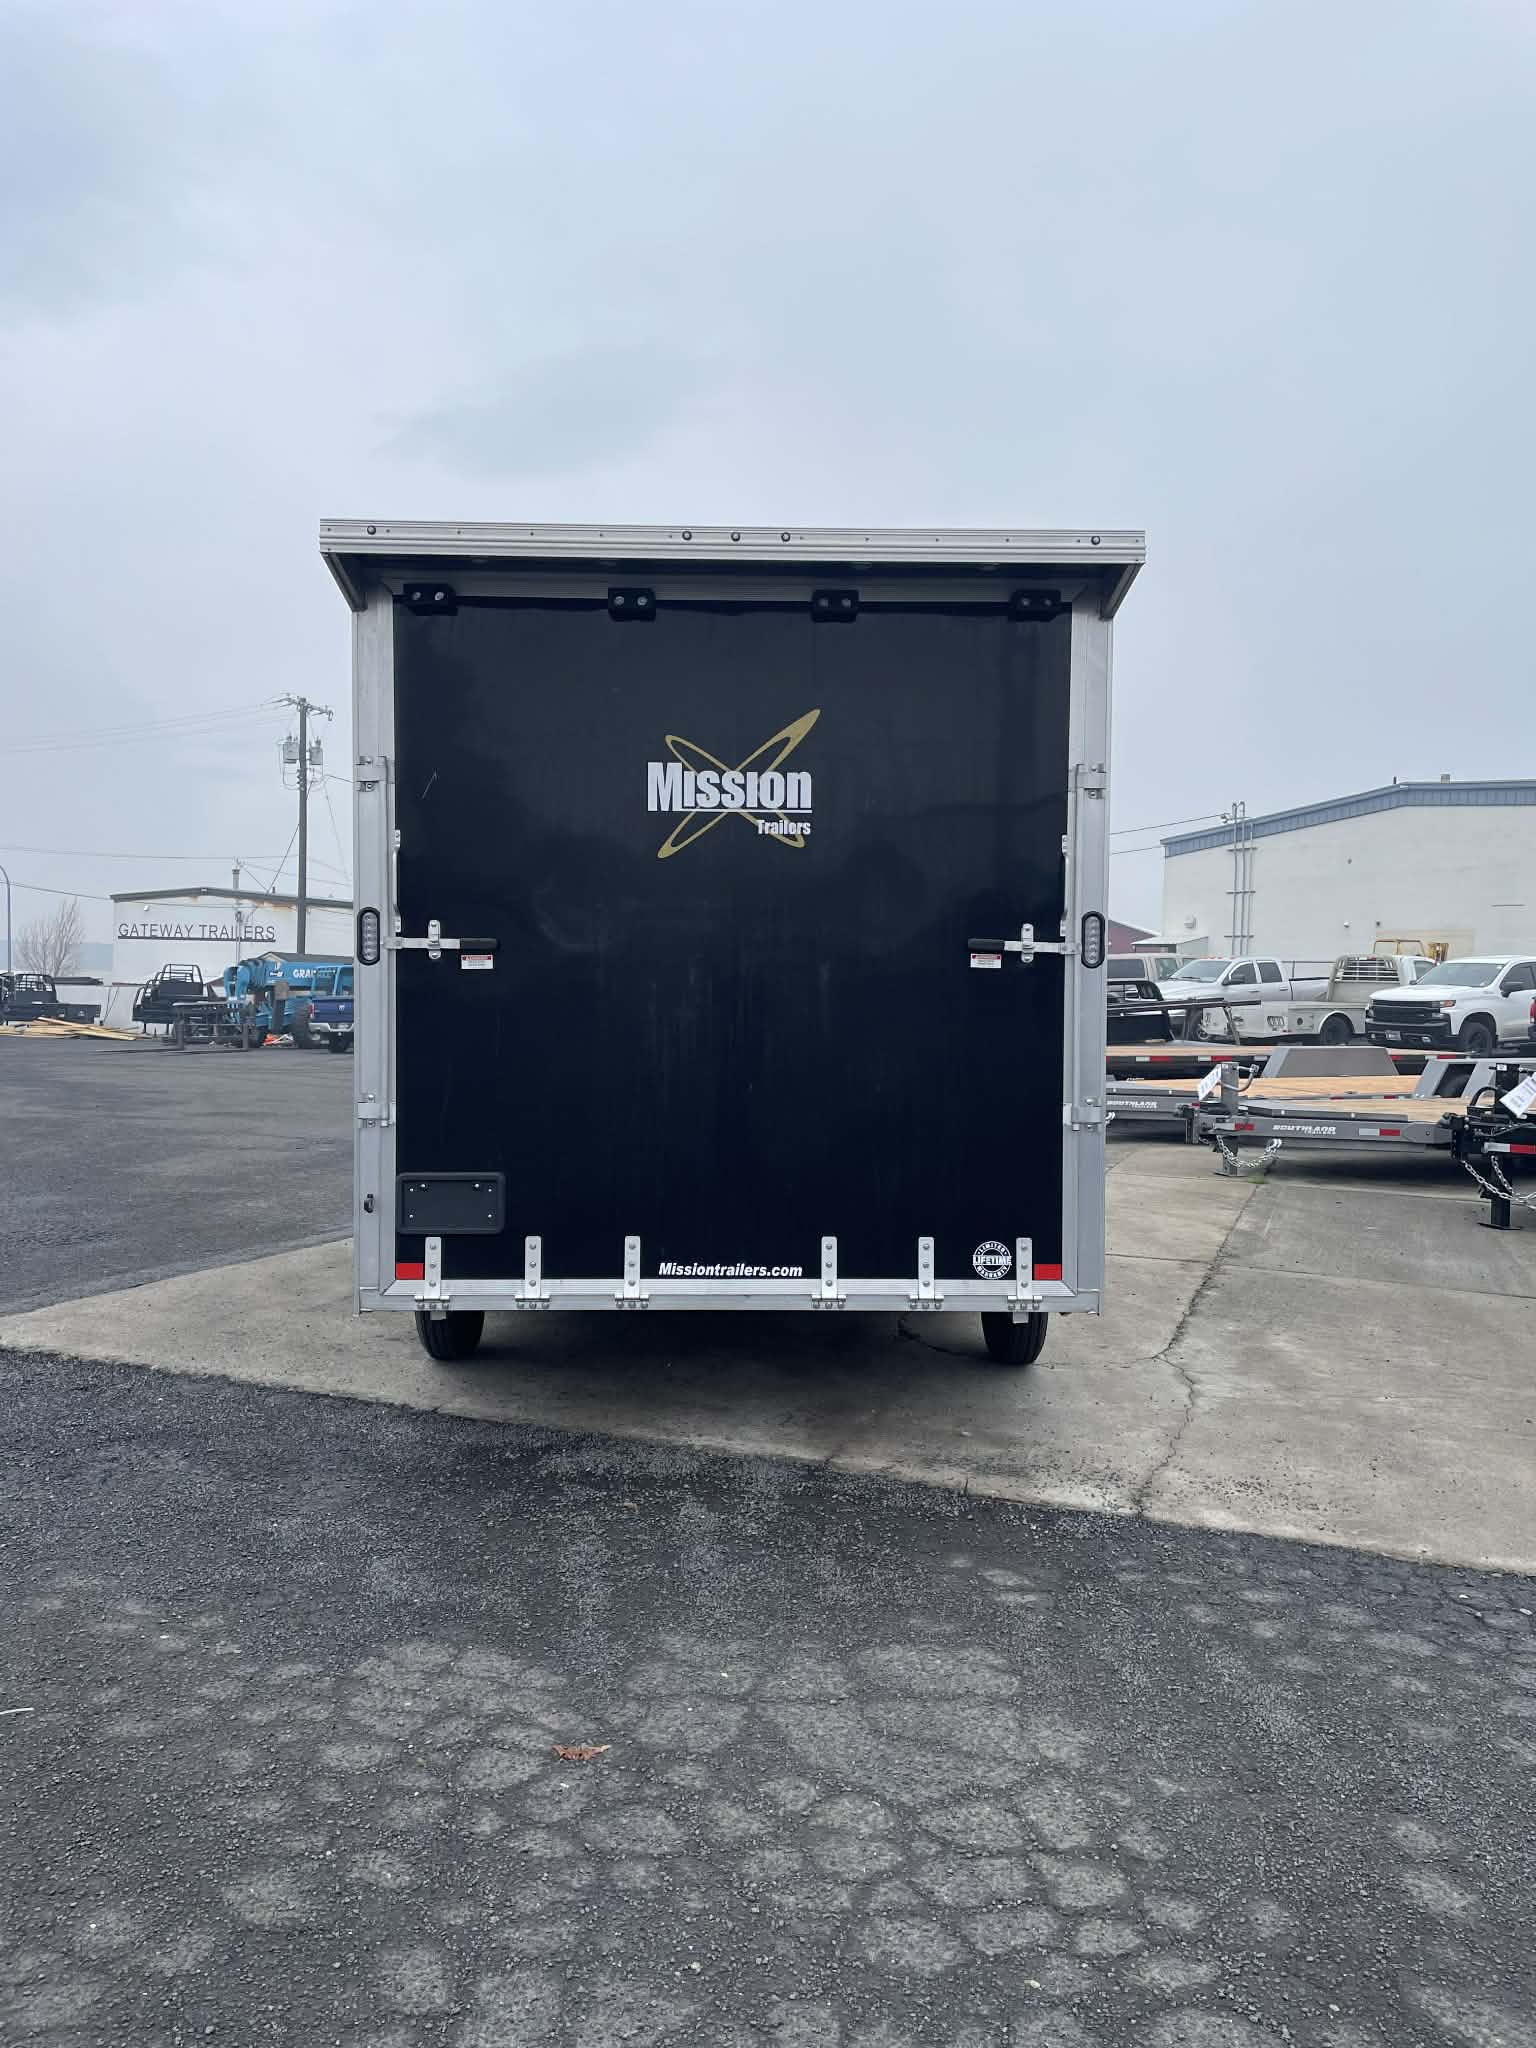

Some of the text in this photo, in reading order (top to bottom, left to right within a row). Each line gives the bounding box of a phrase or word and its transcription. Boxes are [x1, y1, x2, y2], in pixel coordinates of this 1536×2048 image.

[648, 762, 812, 812] Mission
[757, 820, 811, 835] Trailers
[118, 923, 193, 938] GATEWAY
[972, 1255, 1012, 1265] LIFETIME
[658, 1262, 803, 1277] Missiontrailers.com
